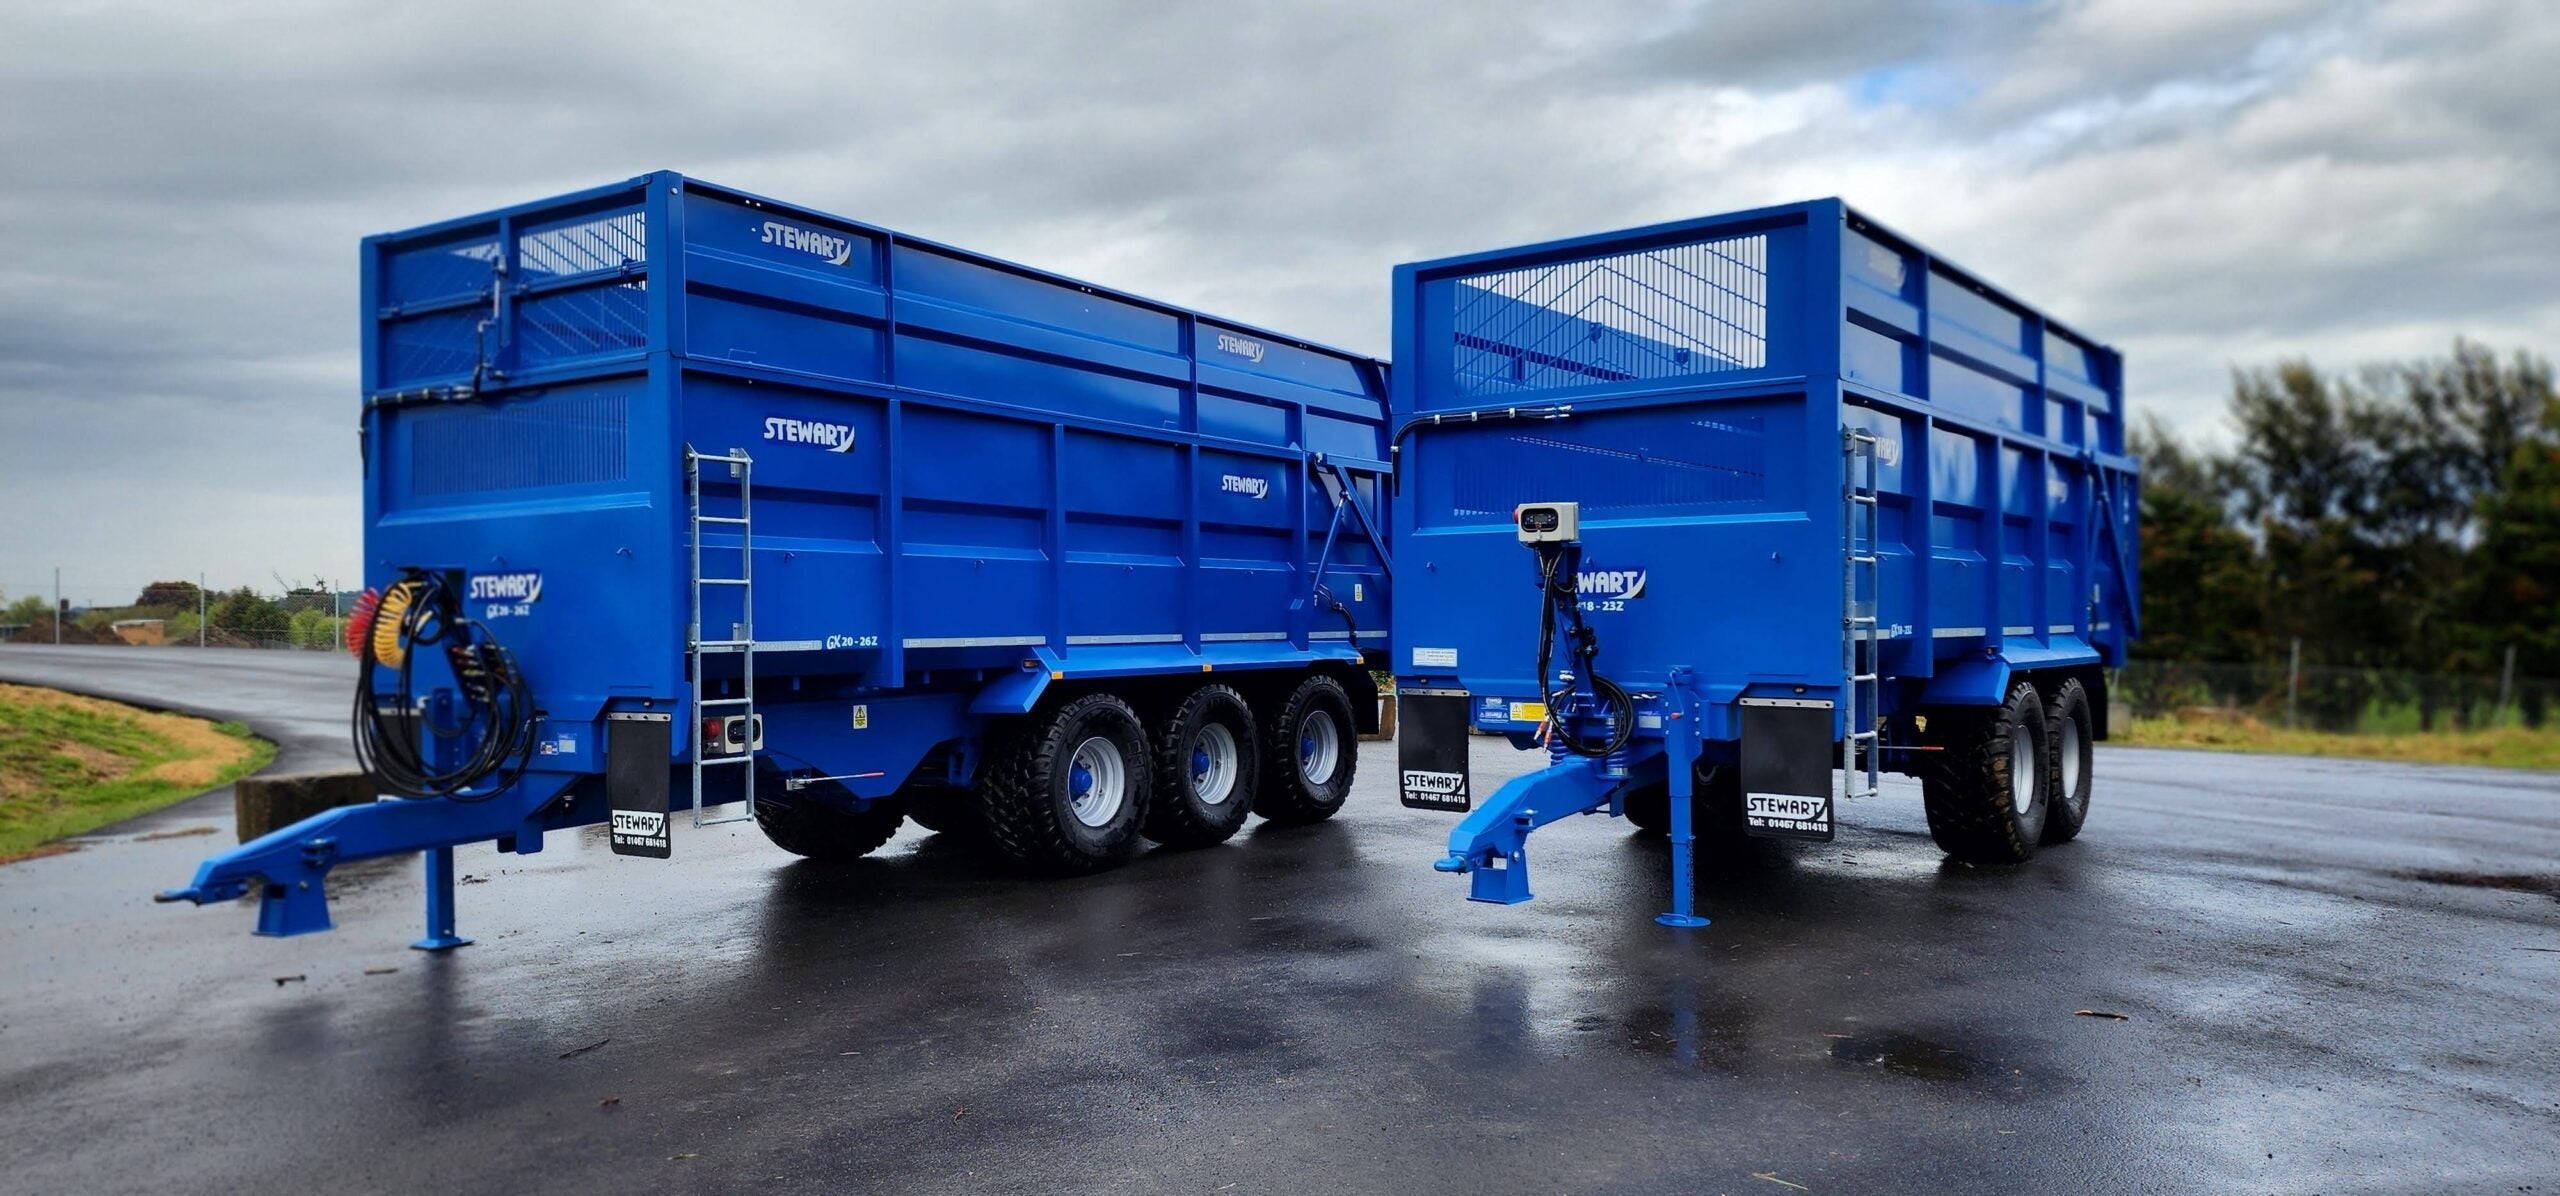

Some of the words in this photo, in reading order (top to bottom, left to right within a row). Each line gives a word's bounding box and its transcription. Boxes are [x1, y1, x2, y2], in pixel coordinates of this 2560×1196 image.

[762, 221, 851, 266] STEWART
[1217, 334, 1264, 363] STEWART
[763, 417, 855, 453] STEWART
[1221, 474, 1268, 499] STEWART
[469, 573, 543, 604] STEWART
[1575, 569, 1646, 599] WART
[1404, 774, 1466, 793] STEWART
[1405, 791, 1418, 800] Tel:
[1441, 794, 1466, 804] 681418
[1746, 797, 1828, 820] STEWART
[612, 814, 666, 837] STEWART
[1748, 817, 1765, 827] Tel:
[1796, 821, 1829, 833] 681418
[613, 834, 625, 845] Tel:
